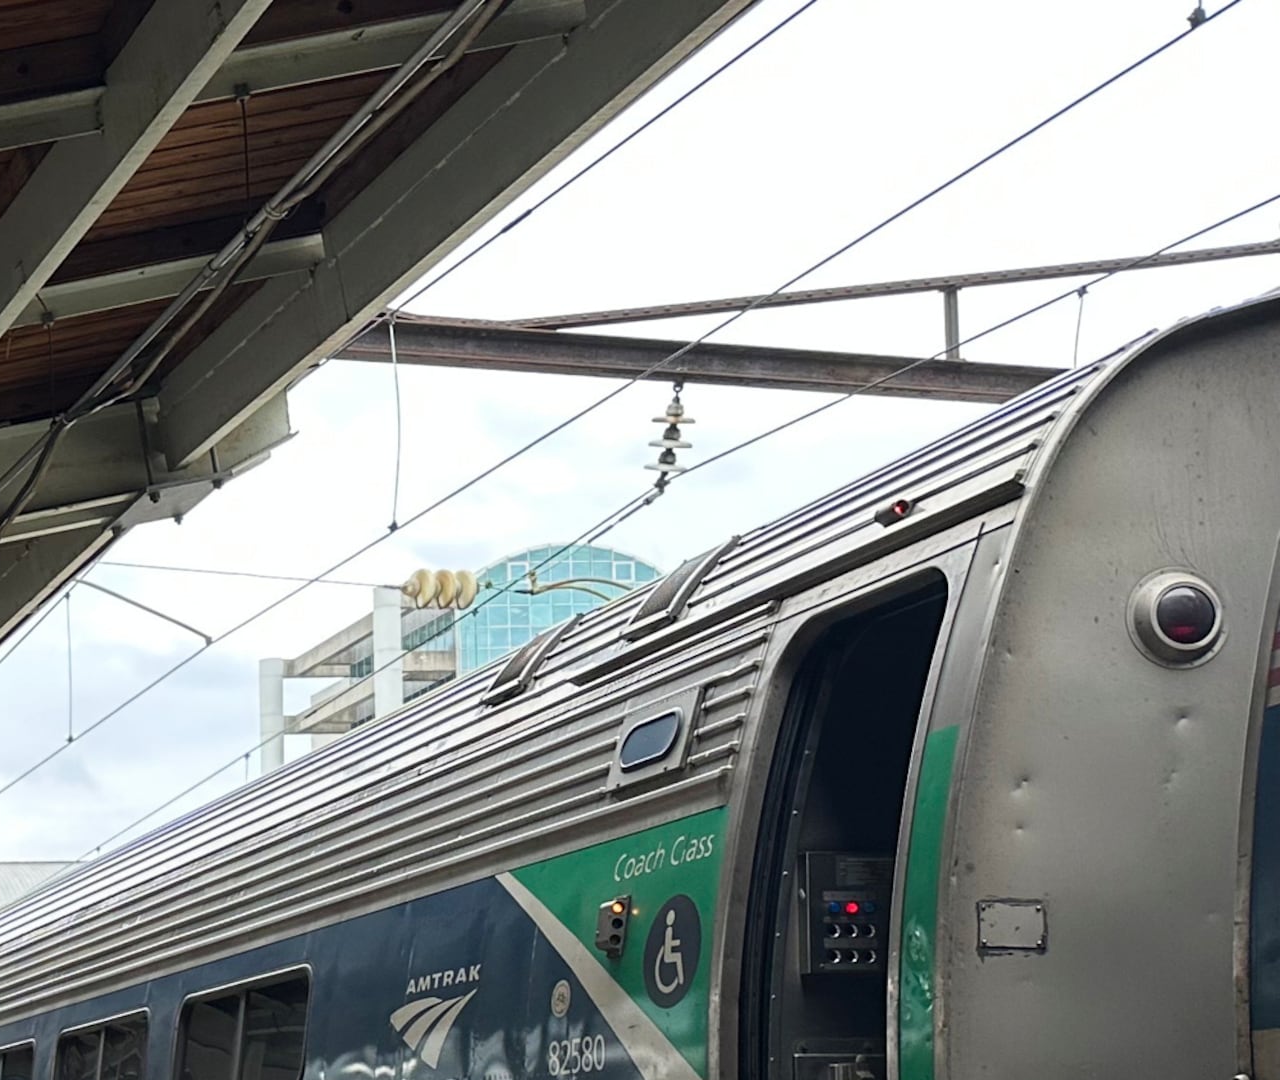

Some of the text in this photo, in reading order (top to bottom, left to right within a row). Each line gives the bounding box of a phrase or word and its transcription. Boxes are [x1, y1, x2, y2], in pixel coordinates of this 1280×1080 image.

[614, 841, 666, 882] Coach
[406, 963, 482, 996] AMTRAK
[548, 1034, 606, 1077] 82580
